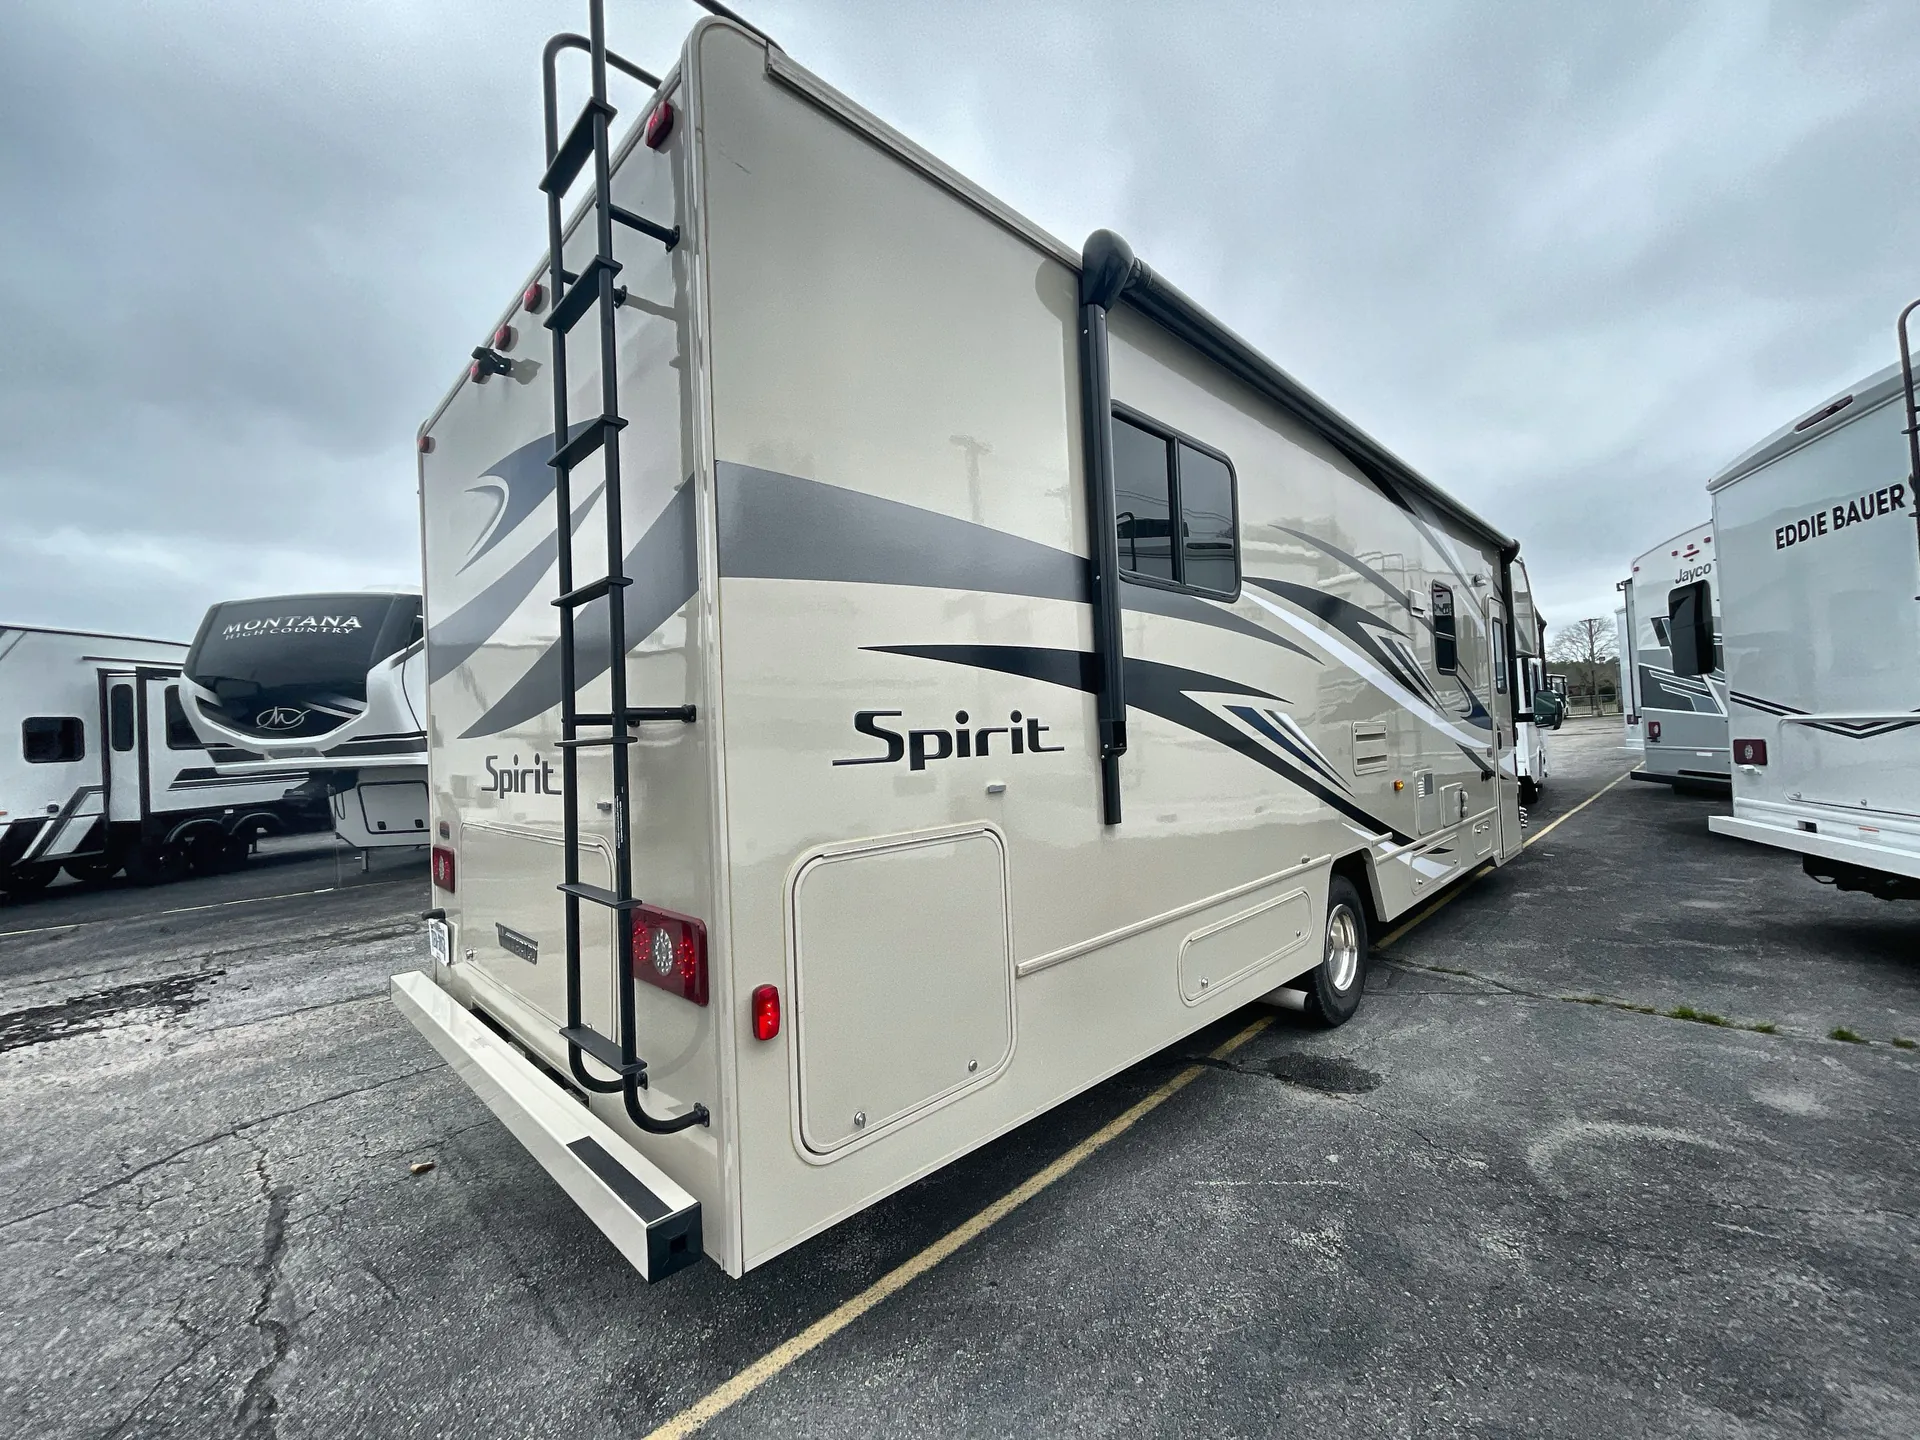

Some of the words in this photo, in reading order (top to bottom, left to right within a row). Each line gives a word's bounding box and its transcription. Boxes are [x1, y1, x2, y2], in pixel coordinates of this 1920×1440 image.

[1775, 511, 1828, 550] EDDIE
[1832, 483, 1906, 531] BAUER
[1674, 562, 1712, 584] Jayco
[222, 615, 362, 635] MONTANA
[225, 629, 264, 640] HIGH
[269, 626, 354, 634] COUNTRY
[832, 709, 1065, 771] Spirit
[481, 752, 562, 799] Spirit
